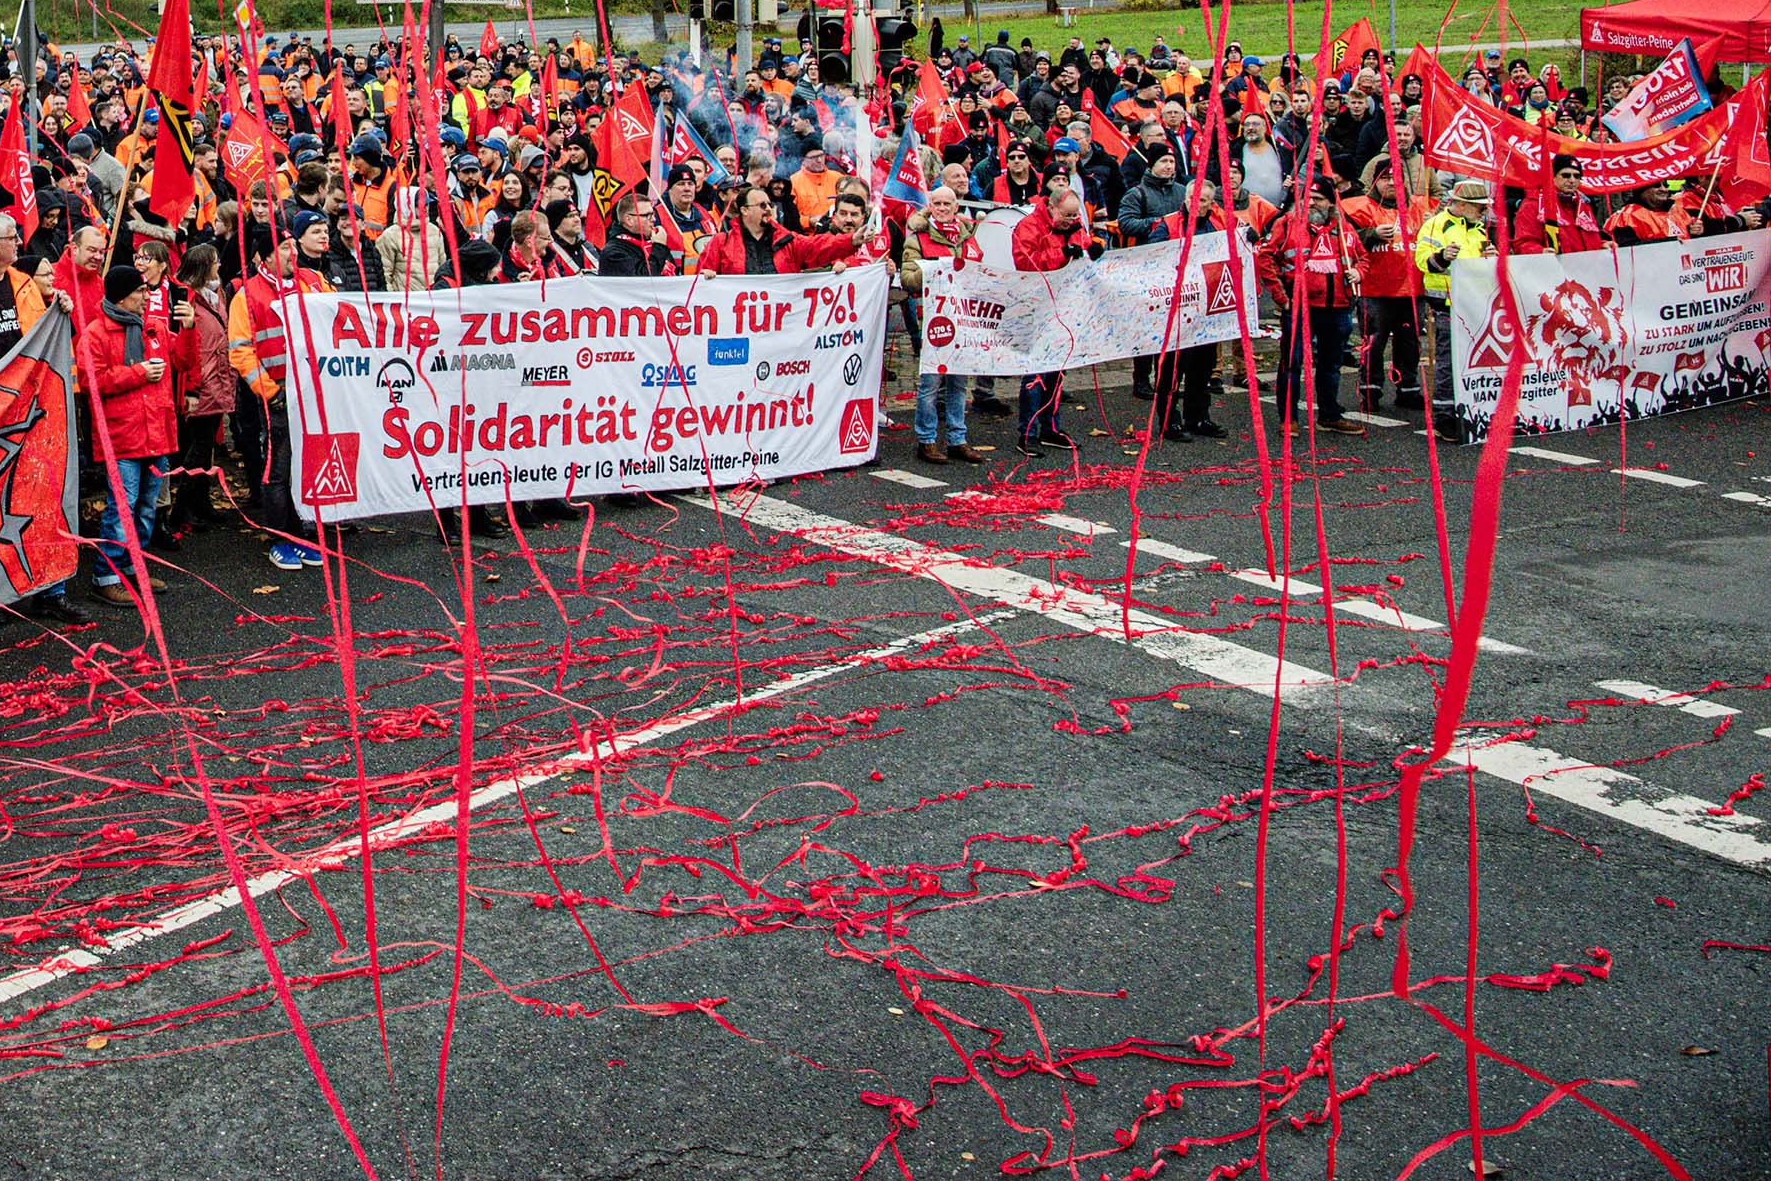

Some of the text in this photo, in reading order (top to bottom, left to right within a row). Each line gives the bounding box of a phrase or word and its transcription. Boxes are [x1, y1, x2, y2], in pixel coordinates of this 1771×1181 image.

[1607, 31, 1674, 50] Salzgitter-Peine
[1148, 282, 1199, 298] SOLIDITÄT
[1165, 292, 1201, 306] GINNT
[333, 282, 859, 351] Alle zusammen für 7%!
[935, 295, 946, 314] 7
[961, 298, 1006, 320] MEHR
[814, 328, 864, 350] ALSTOM
[1645, 329, 1659, 339] ZU
[1662, 324, 1695, 338] STARK
[1697, 320, 1712, 332] UM
[1639, 346, 1655, 356] ZU
[1656, 340, 1686, 353] STOLZ
[1689, 336, 1704, 347] UM
[306, 355, 370, 377] VOITH
[450, 353, 516, 371] MAGNA
[595, 350, 635, 363] STOLL
[522, 365, 569, 383] MEYER
[656, 365, 697, 382] SMAG
[776, 360, 810, 376] BOSCH
[381, 379, 412, 388] MAN
[1462, 369, 1567, 391] Vertransleute
[1473, 391, 1497, 403] MAN
[383, 382, 815, 459] Solidarität gewinnt!
[412, 448, 779, 493] Vertrauensleute der IG Metall Salzgitter-Peine
